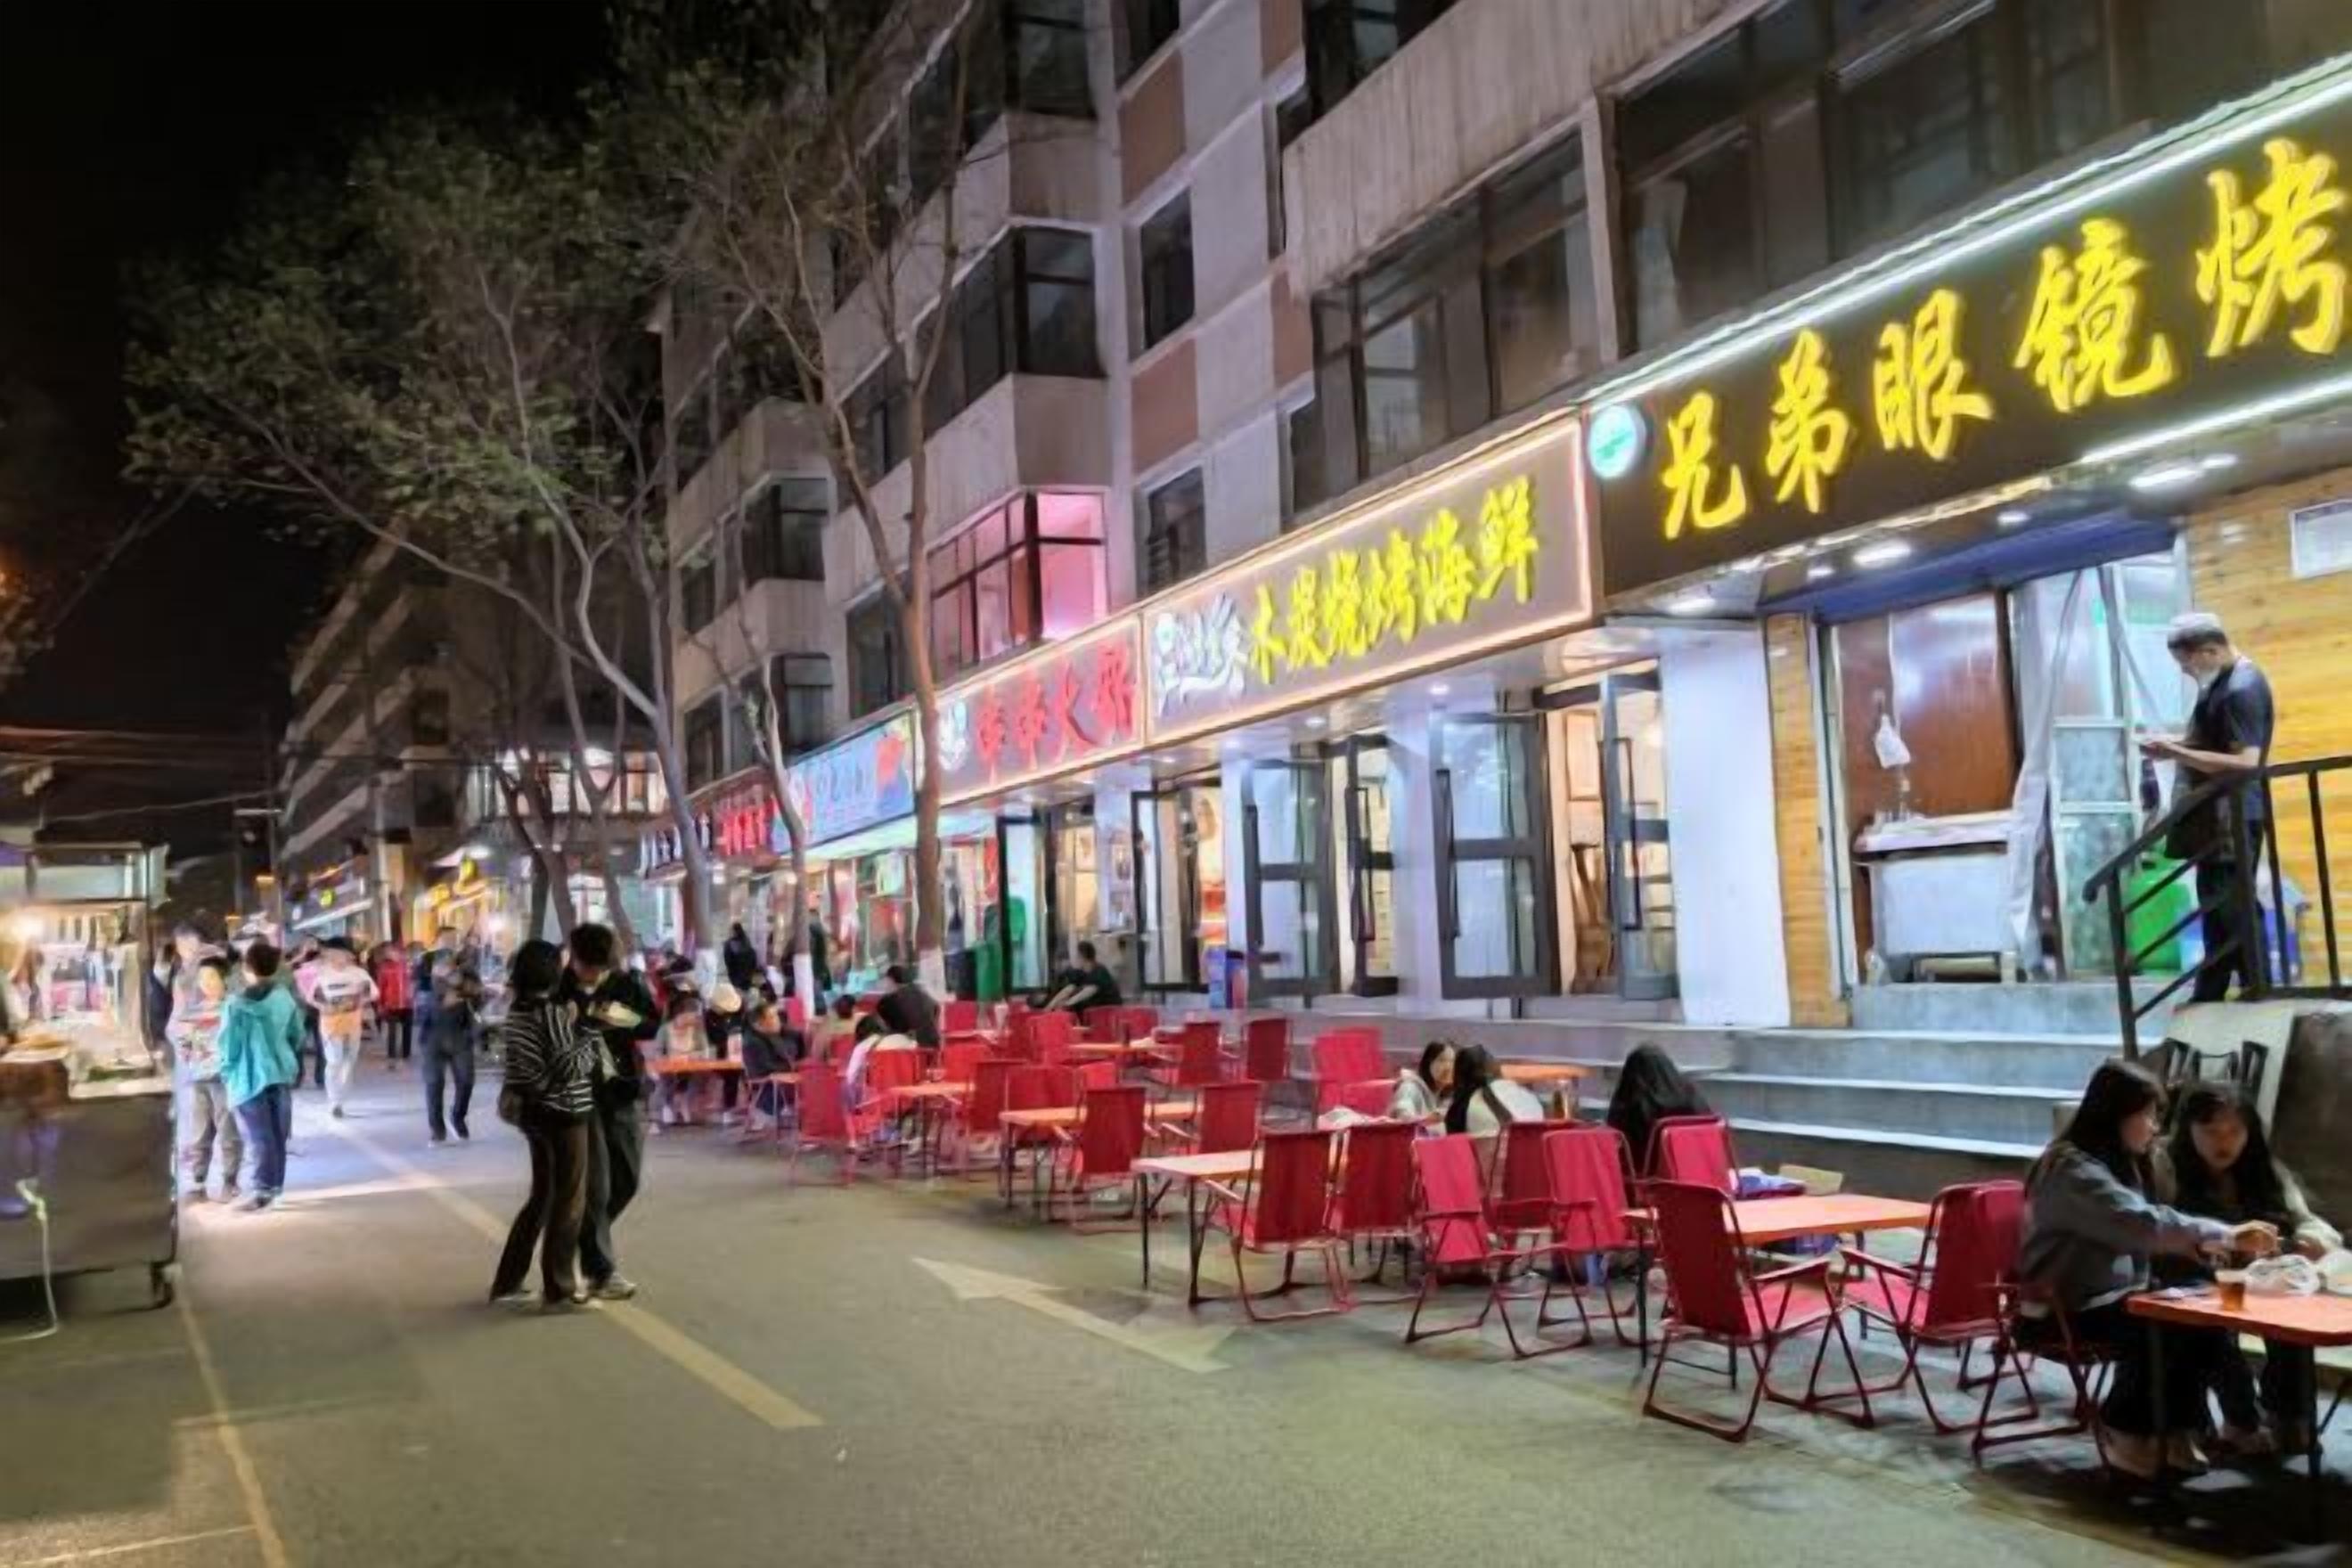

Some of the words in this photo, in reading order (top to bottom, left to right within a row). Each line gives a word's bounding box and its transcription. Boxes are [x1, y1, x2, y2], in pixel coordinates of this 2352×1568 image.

[1659, 137, 2348, 540] 兄弟眼镜烤
